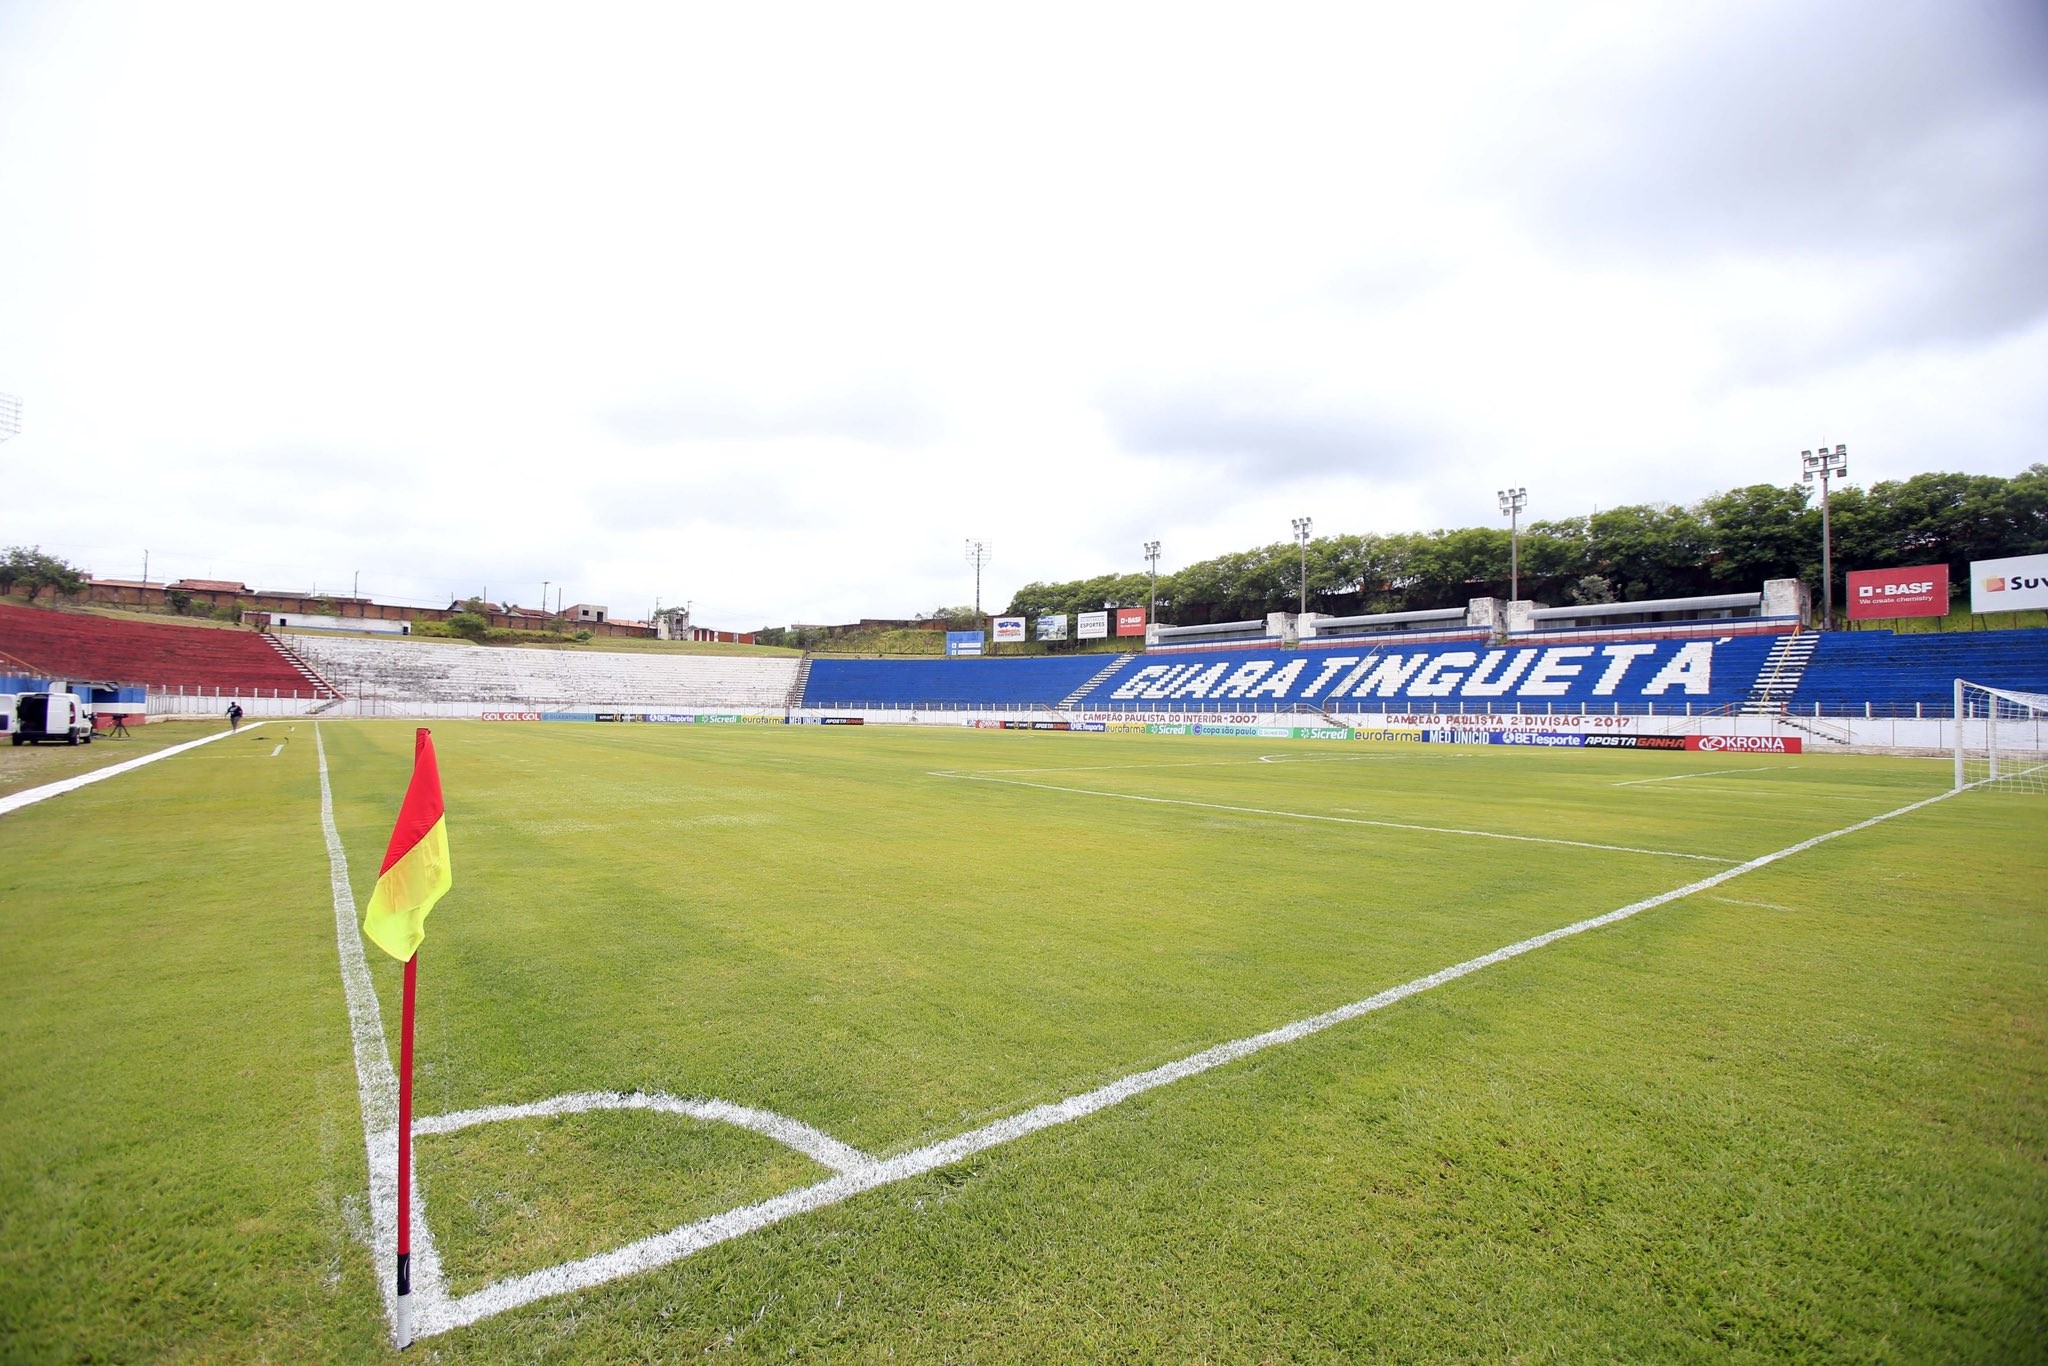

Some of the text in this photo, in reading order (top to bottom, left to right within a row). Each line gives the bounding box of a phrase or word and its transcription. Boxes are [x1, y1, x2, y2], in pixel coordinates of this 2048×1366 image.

[1884, 582, 1933, 595] BASF
[710, 715, 737, 723] Sicredi
[742, 716, 785, 724] eurofarma
[1125, 714, 1165, 722] PAULISTA
[1169, 714, 1180, 722] DO
[1184, 714, 1222, 723] INTERIOR
[1229, 715, 1257, 723] 2007
[1446, 715, 1503, 725] PAULISTA
[1594, 717, 1630, 727] 2017
[1106, 724, 1145, 733] eurofarma
[1159, 724, 1186, 734] Sicredi
[1203, 727, 1220, 735] copa
[1222, 726, 1233, 734] são
[1235, 727, 1256, 736] paulo
[1310, 728, 1348, 739] Sicredi
[1354, 730, 1420, 741] eurofarma
[1430, 730, 1489, 744] MED UNICID
[1515, 733, 1580, 746] BETesporte
[1727, 736, 1784, 748] KRONA
